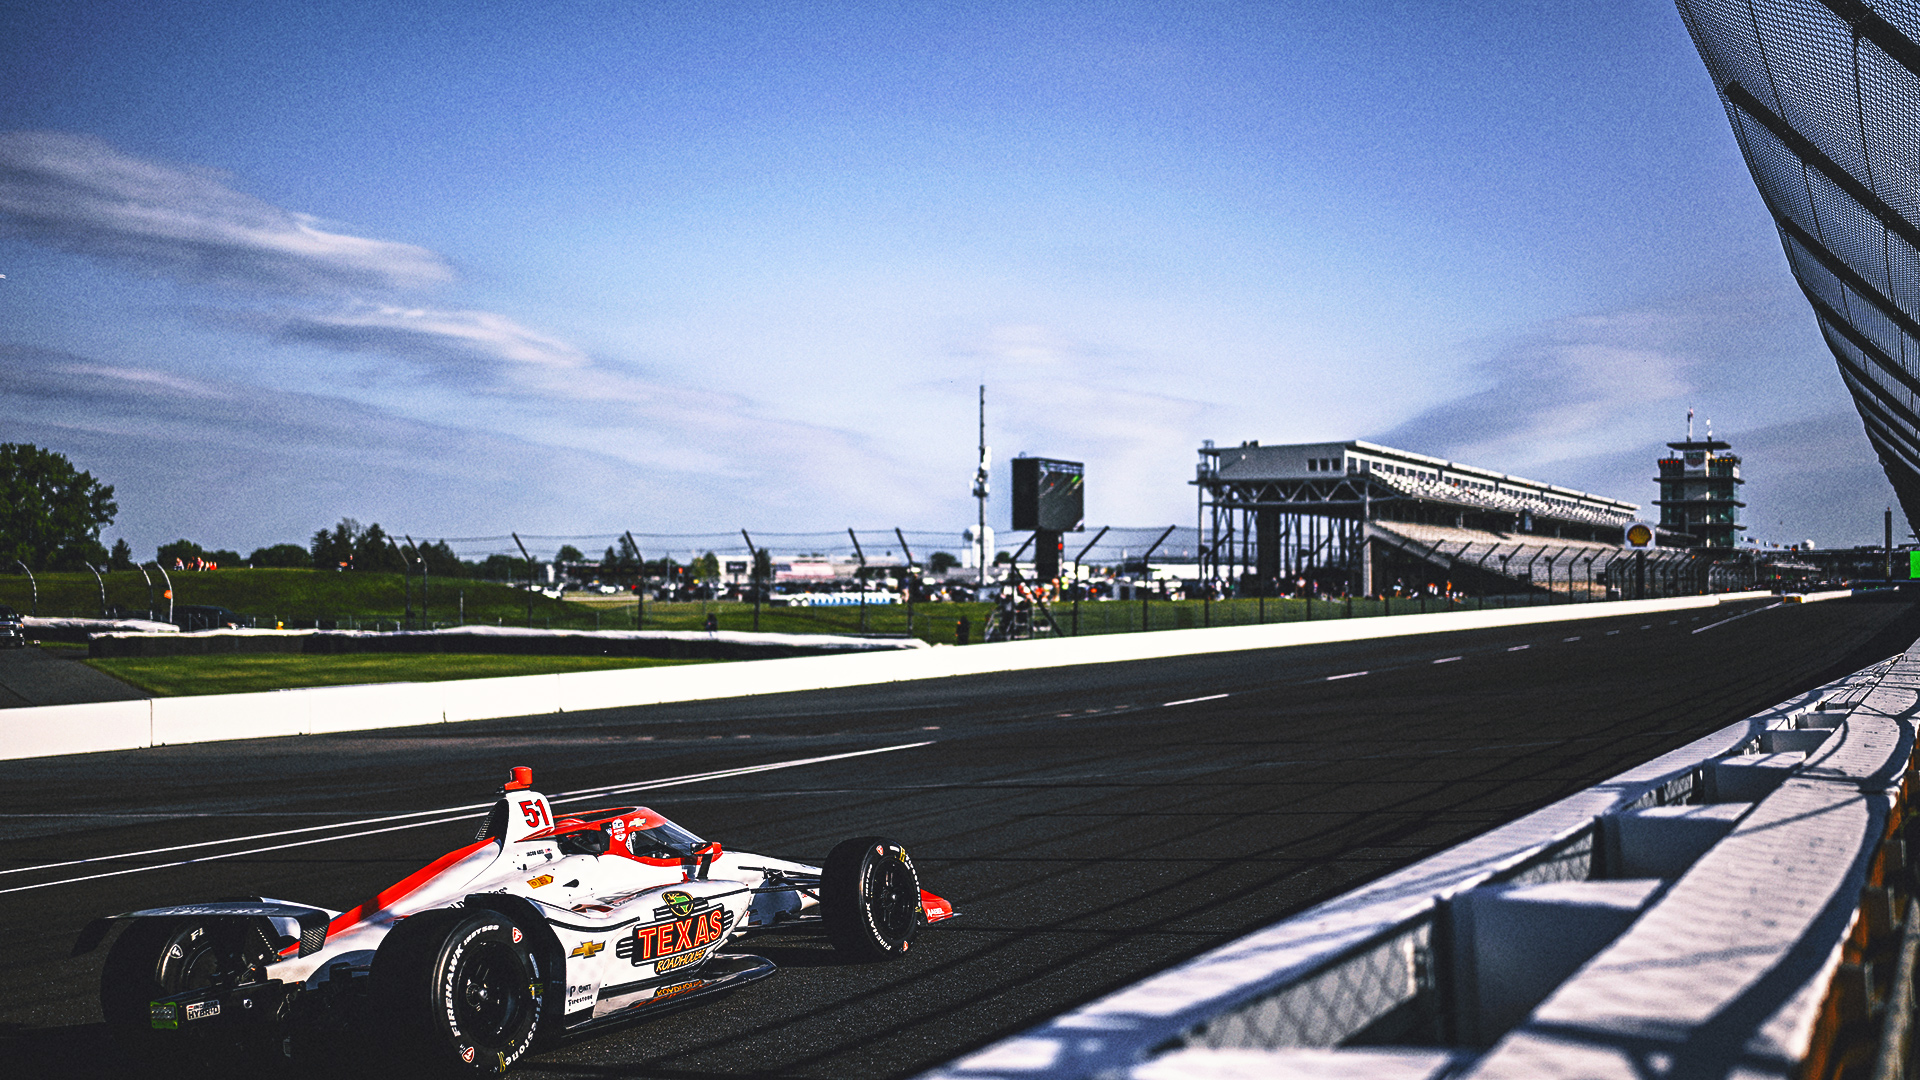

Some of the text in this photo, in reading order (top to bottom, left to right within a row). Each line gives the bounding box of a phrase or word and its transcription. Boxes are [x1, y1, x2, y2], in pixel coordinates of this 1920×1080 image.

[518, 799, 550, 828] 51
[637, 910, 722, 960] TEXAS
[655, 947, 707, 973] ROADHOUSE
[445, 943, 464, 1038] FIREHAWK
[567, 994, 593, 1007] Firestone
[188, 1006, 219, 1020] HYBRID
